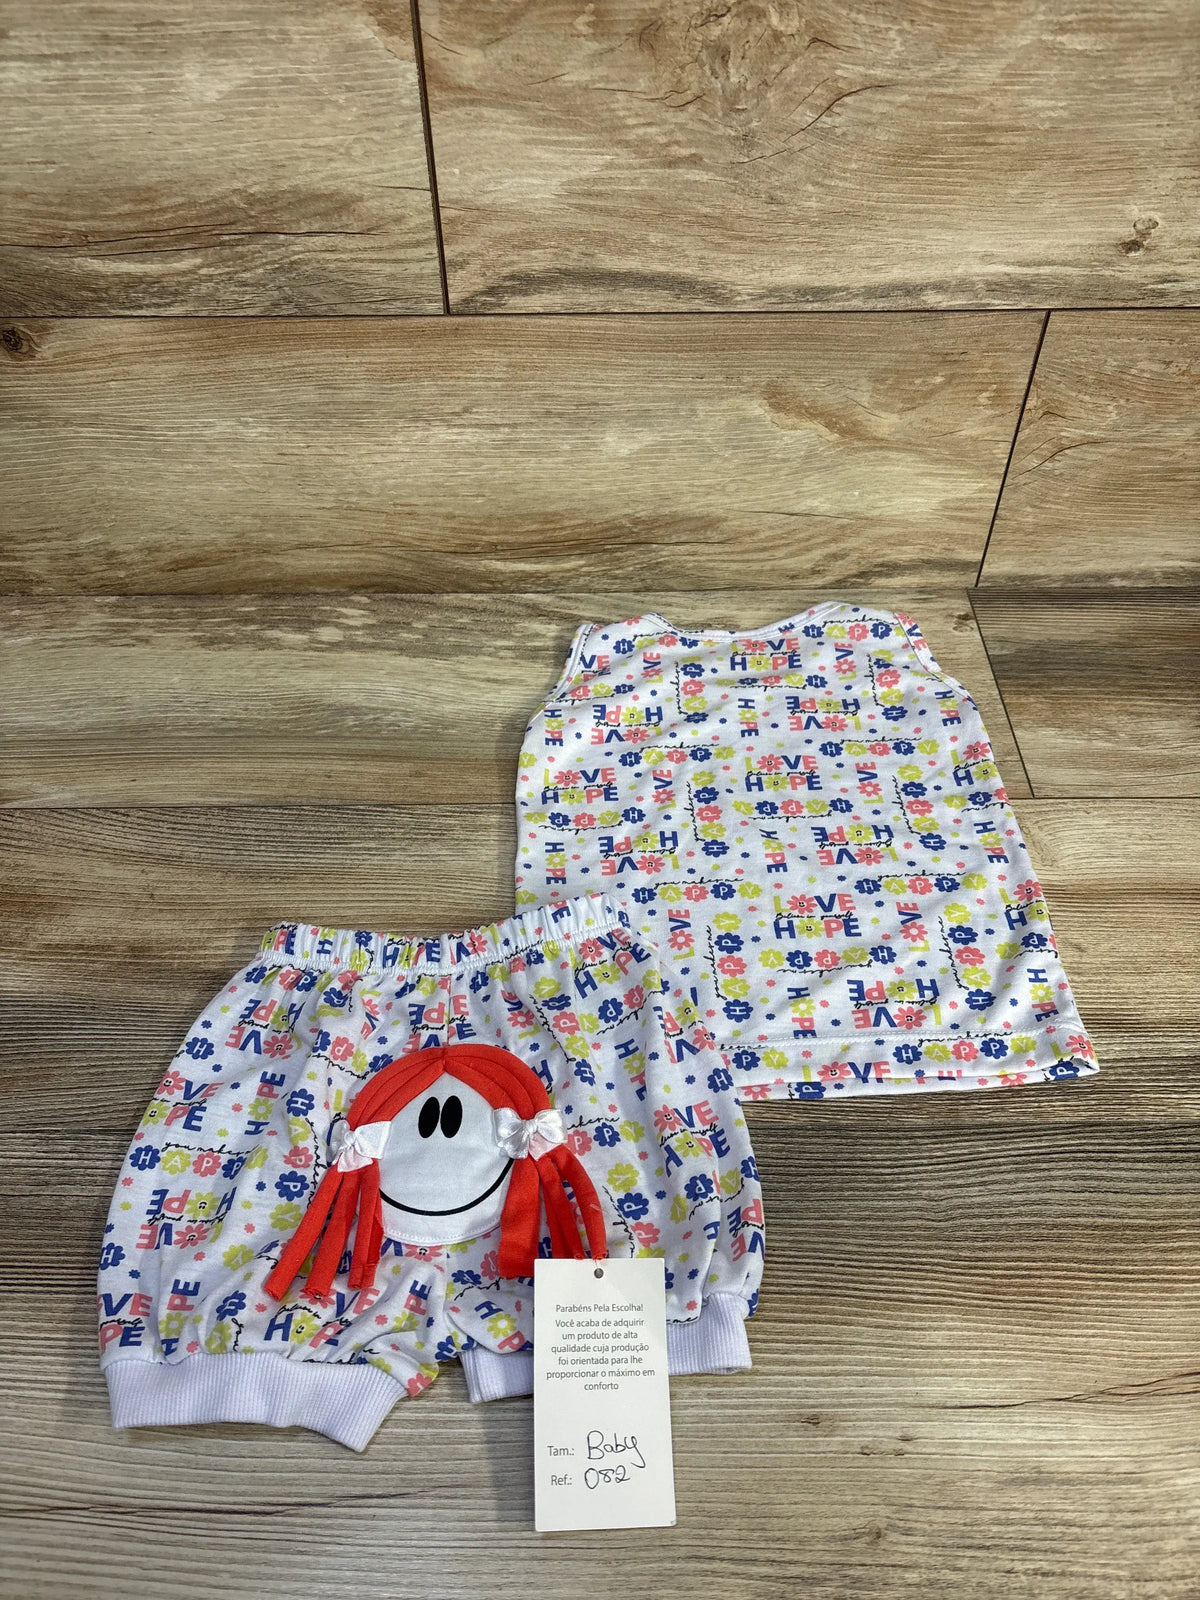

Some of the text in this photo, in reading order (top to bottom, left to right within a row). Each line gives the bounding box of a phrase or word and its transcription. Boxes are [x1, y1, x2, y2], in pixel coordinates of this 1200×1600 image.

[555, 1303, 644, 1313] Parabéns Pela Escolha!
[555, 1319, 645, 1328] Você acaba de adquirir
[577, 1331, 610, 1342] produto
[611, 1331, 622, 1339] de
[623, 1331, 638, 1339] alta
[551, 1343, 649, 1355] qualidade cuja produção
[558, 1355, 643, 1366] foi orientada para lhe
[546, 1369, 599, 1380] proporcionar
[608, 1368, 641, 1377] máximo
[642, 1369, 656, 1377] em
[584, 1381, 619, 1391] conforto
[546, 1430, 646, 1469] Tam.: Baby
[550, 1464, 631, 1490] Ref.: 082
